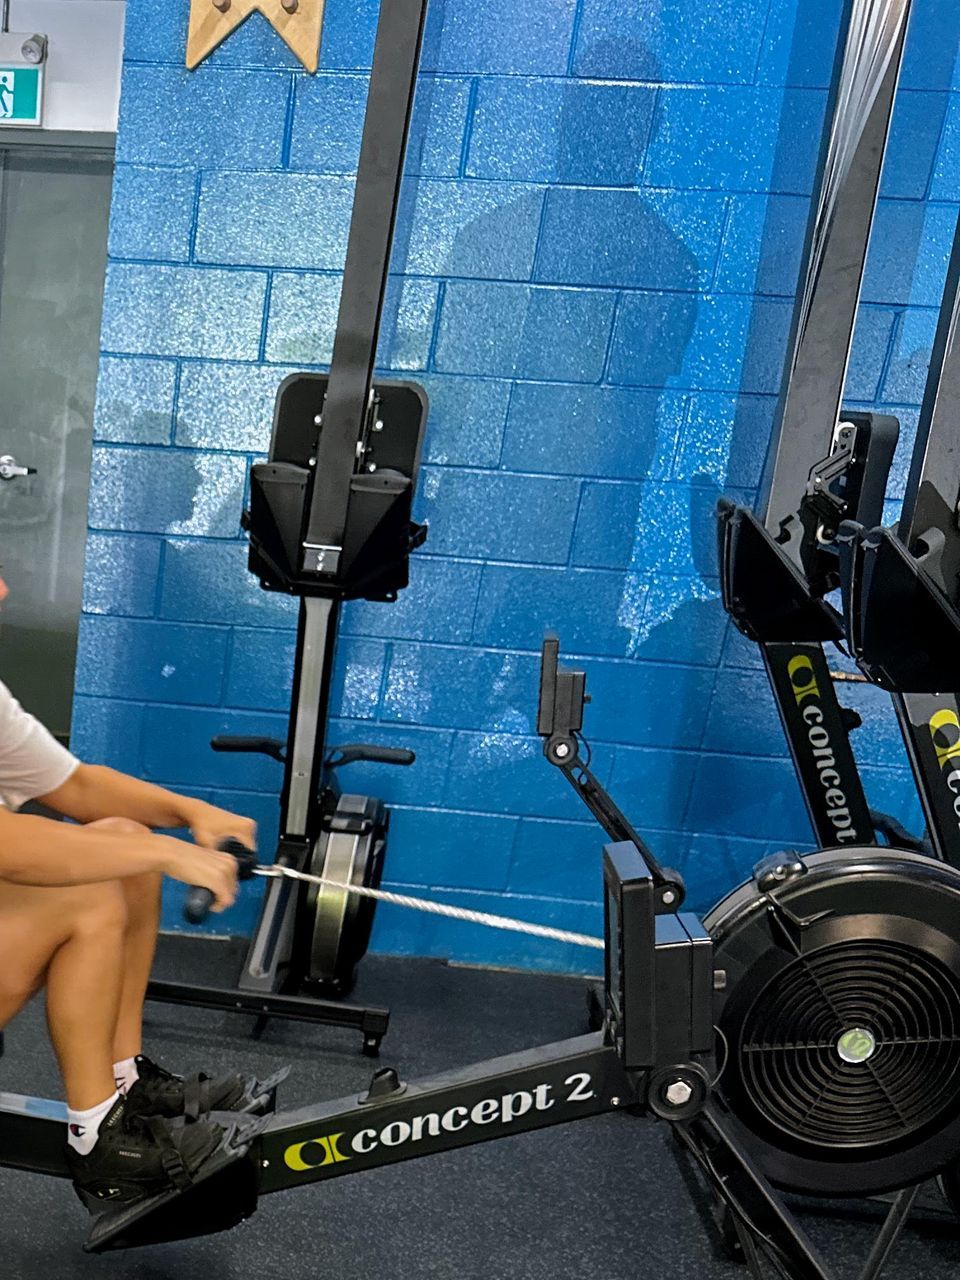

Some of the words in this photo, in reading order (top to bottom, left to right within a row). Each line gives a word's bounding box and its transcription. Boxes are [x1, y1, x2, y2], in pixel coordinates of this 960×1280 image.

[802, 705, 857, 843] concept
[351, 1083, 555, 1153] concept
[563, 1072, 594, 1101] 2
